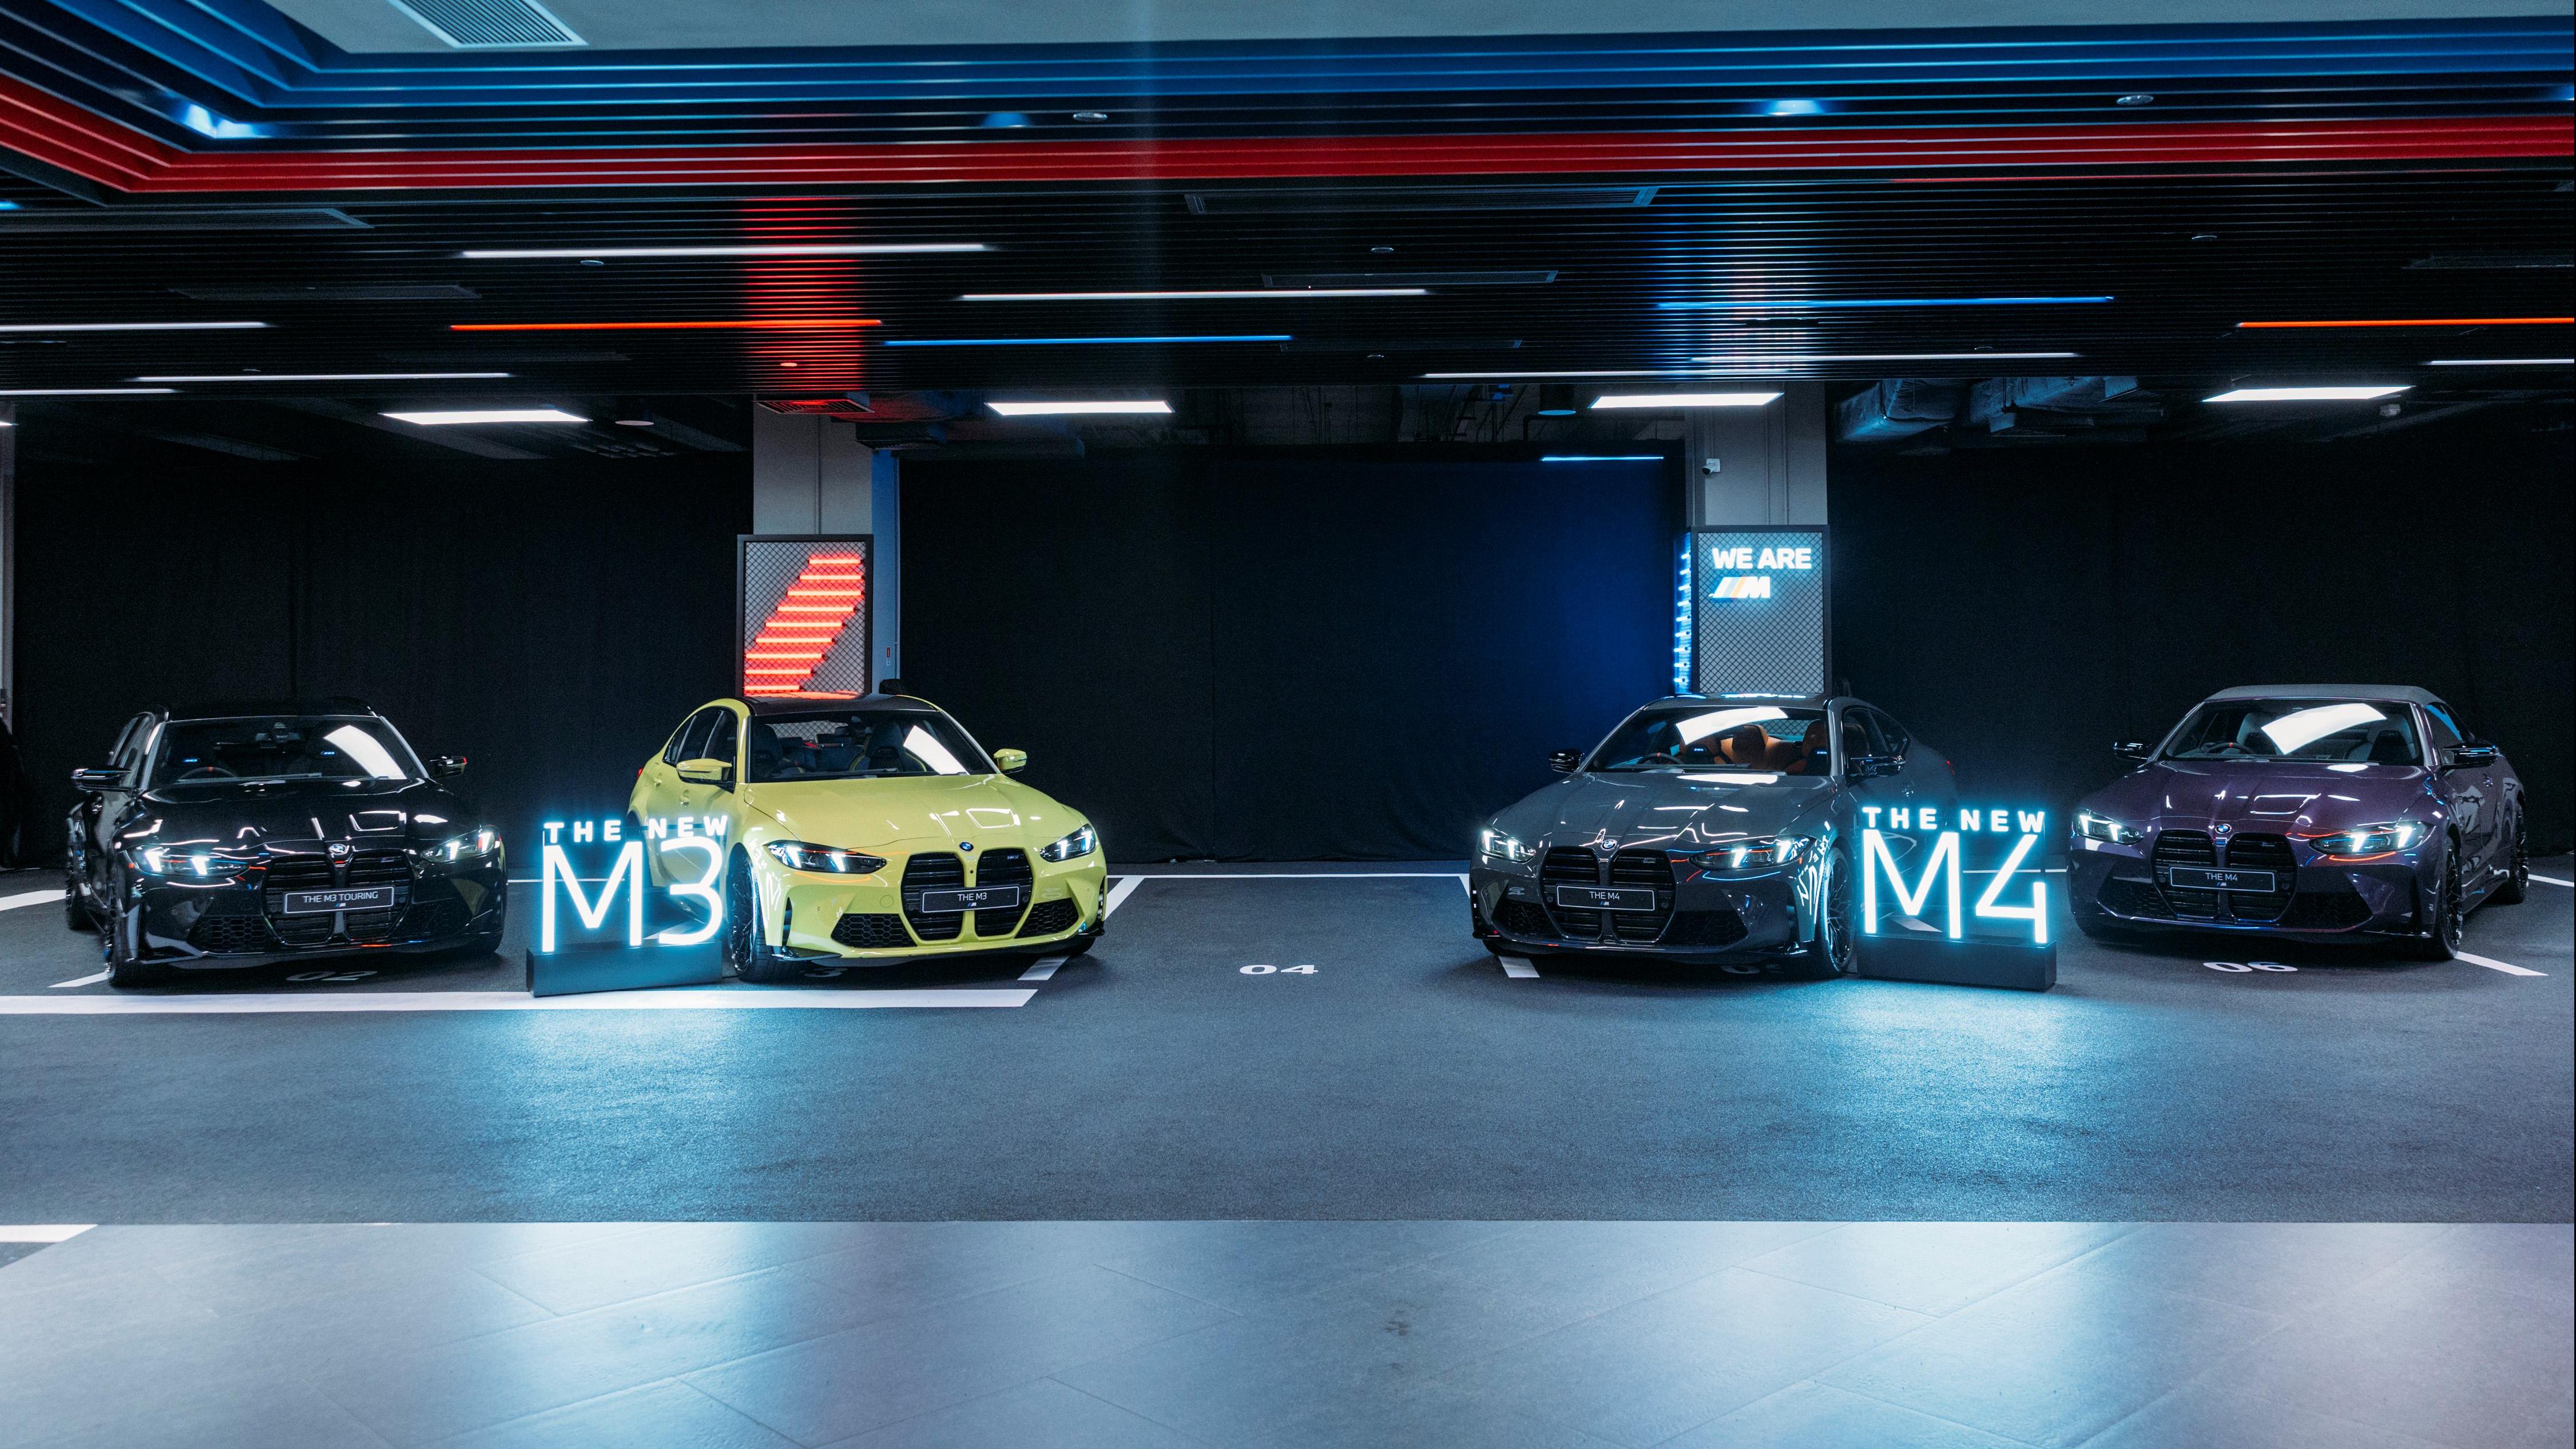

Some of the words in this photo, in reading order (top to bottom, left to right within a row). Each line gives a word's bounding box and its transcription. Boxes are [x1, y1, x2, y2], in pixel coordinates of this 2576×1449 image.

[1712, 547, 1753, 569] WE
[1757, 547, 1812, 569] ARE
[1862, 807, 1938, 830] THE
[1960, 809, 2045, 833] NEW
[543, 819, 621, 843] THE
[648, 815, 728, 839] NEW
[2205, 872, 2223, 880] THE
[1863, 829, 2047, 943] M4
[339, 891, 379, 901] TOURING
[542, 836, 723, 952] M3
[1589, 891, 1606, 899] THE
[1239, 964, 1319, 975] 04
[2203, 962, 2298, 972] 06
[286, 971, 378, 980] 02
